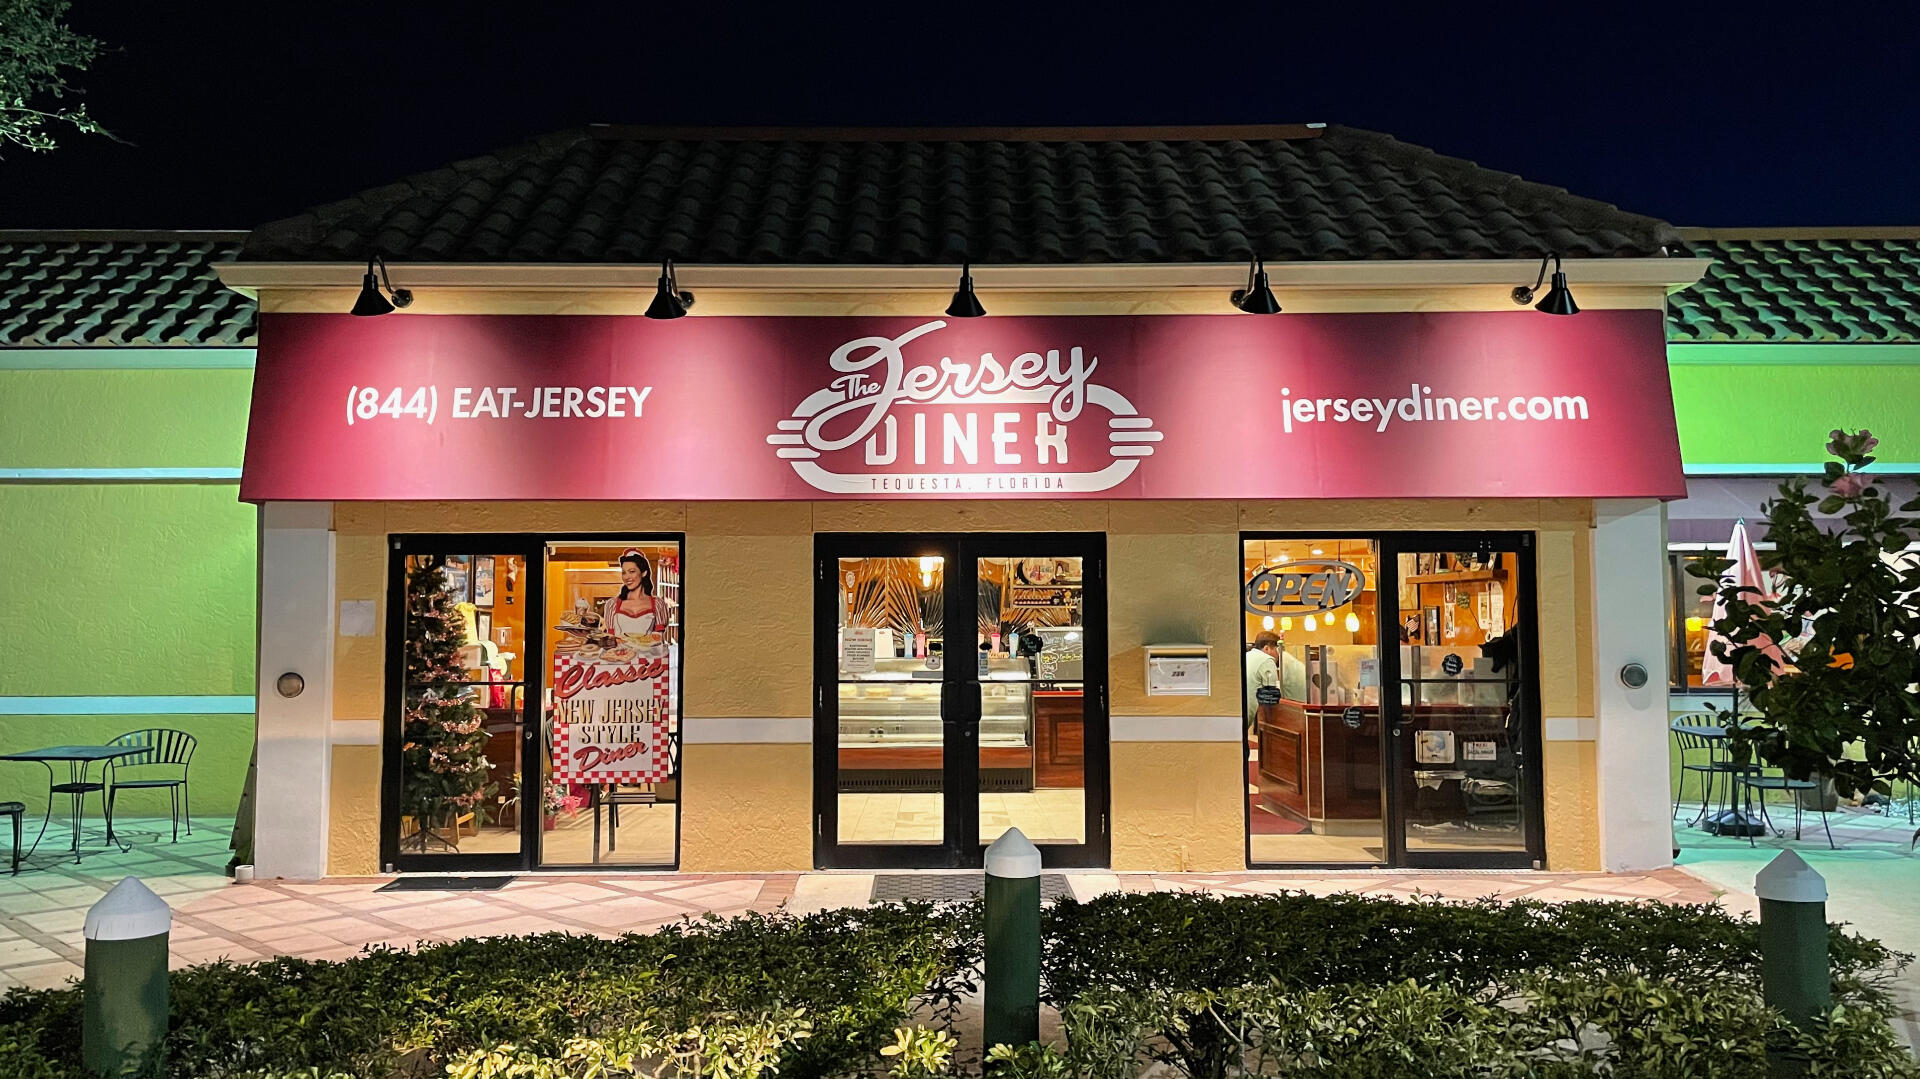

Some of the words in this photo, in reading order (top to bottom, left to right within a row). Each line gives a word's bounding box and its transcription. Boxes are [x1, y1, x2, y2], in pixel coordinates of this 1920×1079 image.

[805, 320, 1098, 451] Jersey
[831, 373, 880, 400] The
[347, 385, 438, 425] (844)
[452, 386, 652, 418] EAT-JERSEY
[1281, 384, 1589, 433] jerseydiner.com
[865, 413, 1068, 465] DINER
[986, 477, 1064, 489] FLORIDA
[1250, 573, 1352, 606] OPEN
[554, 660, 666, 699] Classic
[557, 699, 595, 724] NEW
[600, 699, 667, 723] JERSEY
[578, 725, 641, 744] STYLE
[573, 741, 649, 771] Diner
